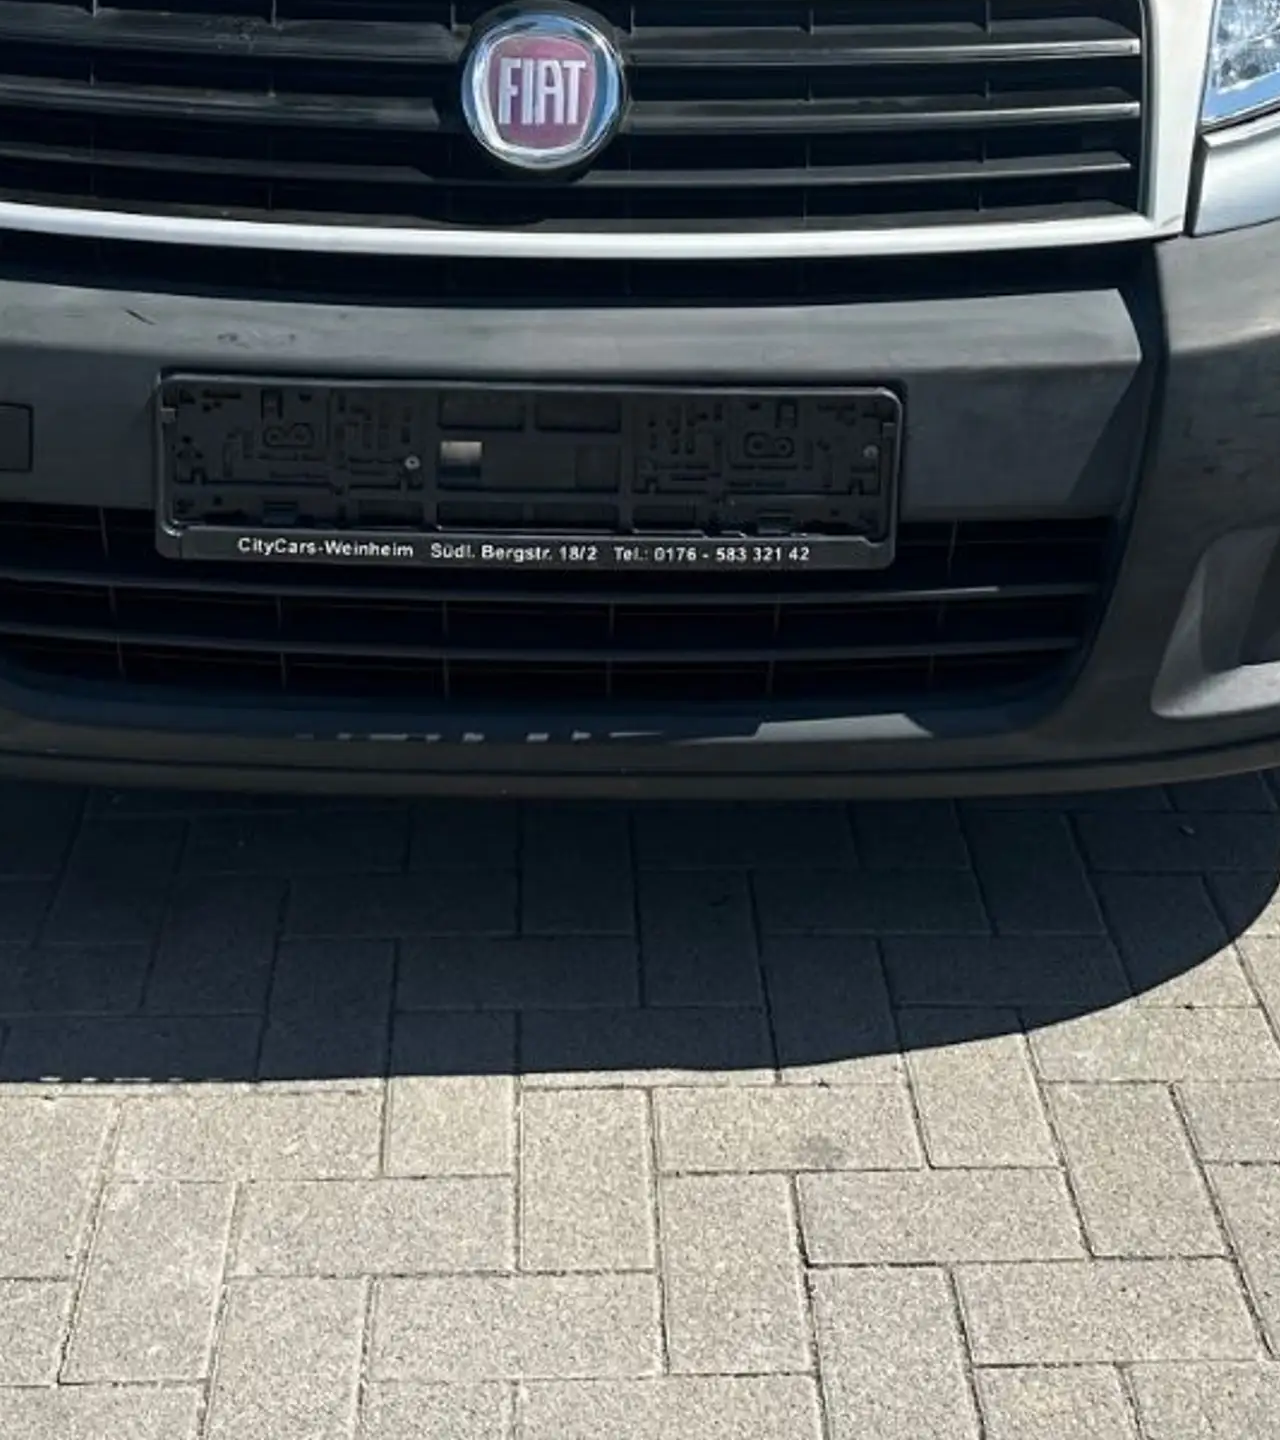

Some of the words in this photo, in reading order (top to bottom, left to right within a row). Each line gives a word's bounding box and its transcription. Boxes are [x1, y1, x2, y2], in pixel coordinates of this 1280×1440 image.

[498, 57, 586, 126] FIAT
[237, 536, 415, 559] CityCars-Weinheim
[430, 541, 476, 560] Südl.
[481, 543, 552, 563] Bergstr.
[558, 544, 599, 562] 18/2
[614, 546, 649, 562] Tel.:
[653, 546, 698, 562] 0176
[715, 546, 748, 563] 583
[752, 546, 783, 563] 321
[788, 546, 811, 563] 42
